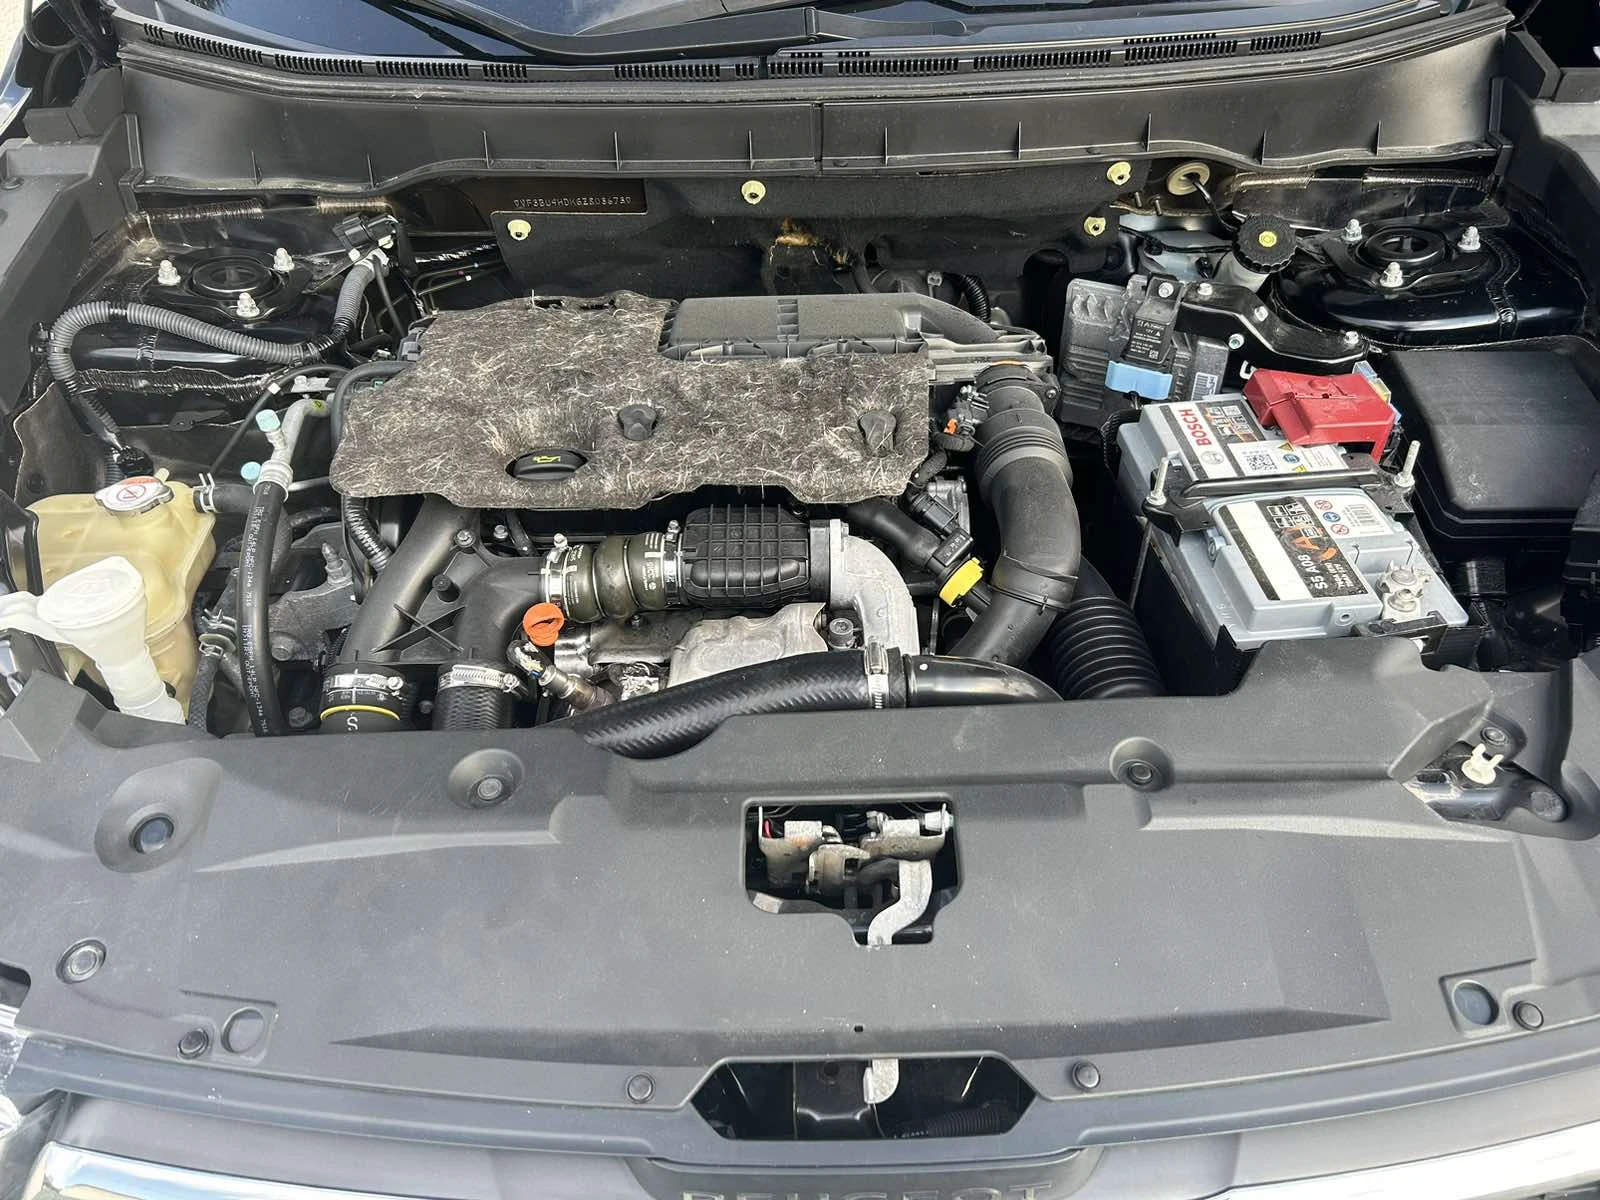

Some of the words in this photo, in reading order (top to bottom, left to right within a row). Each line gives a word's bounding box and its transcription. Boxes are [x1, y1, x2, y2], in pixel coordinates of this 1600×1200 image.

[1178, 409, 1212, 446] BOSCH
[1297, 554, 1320, 573] A08
[1311, 575, 1328, 589] S5
[346, 716, 359, 731] S
